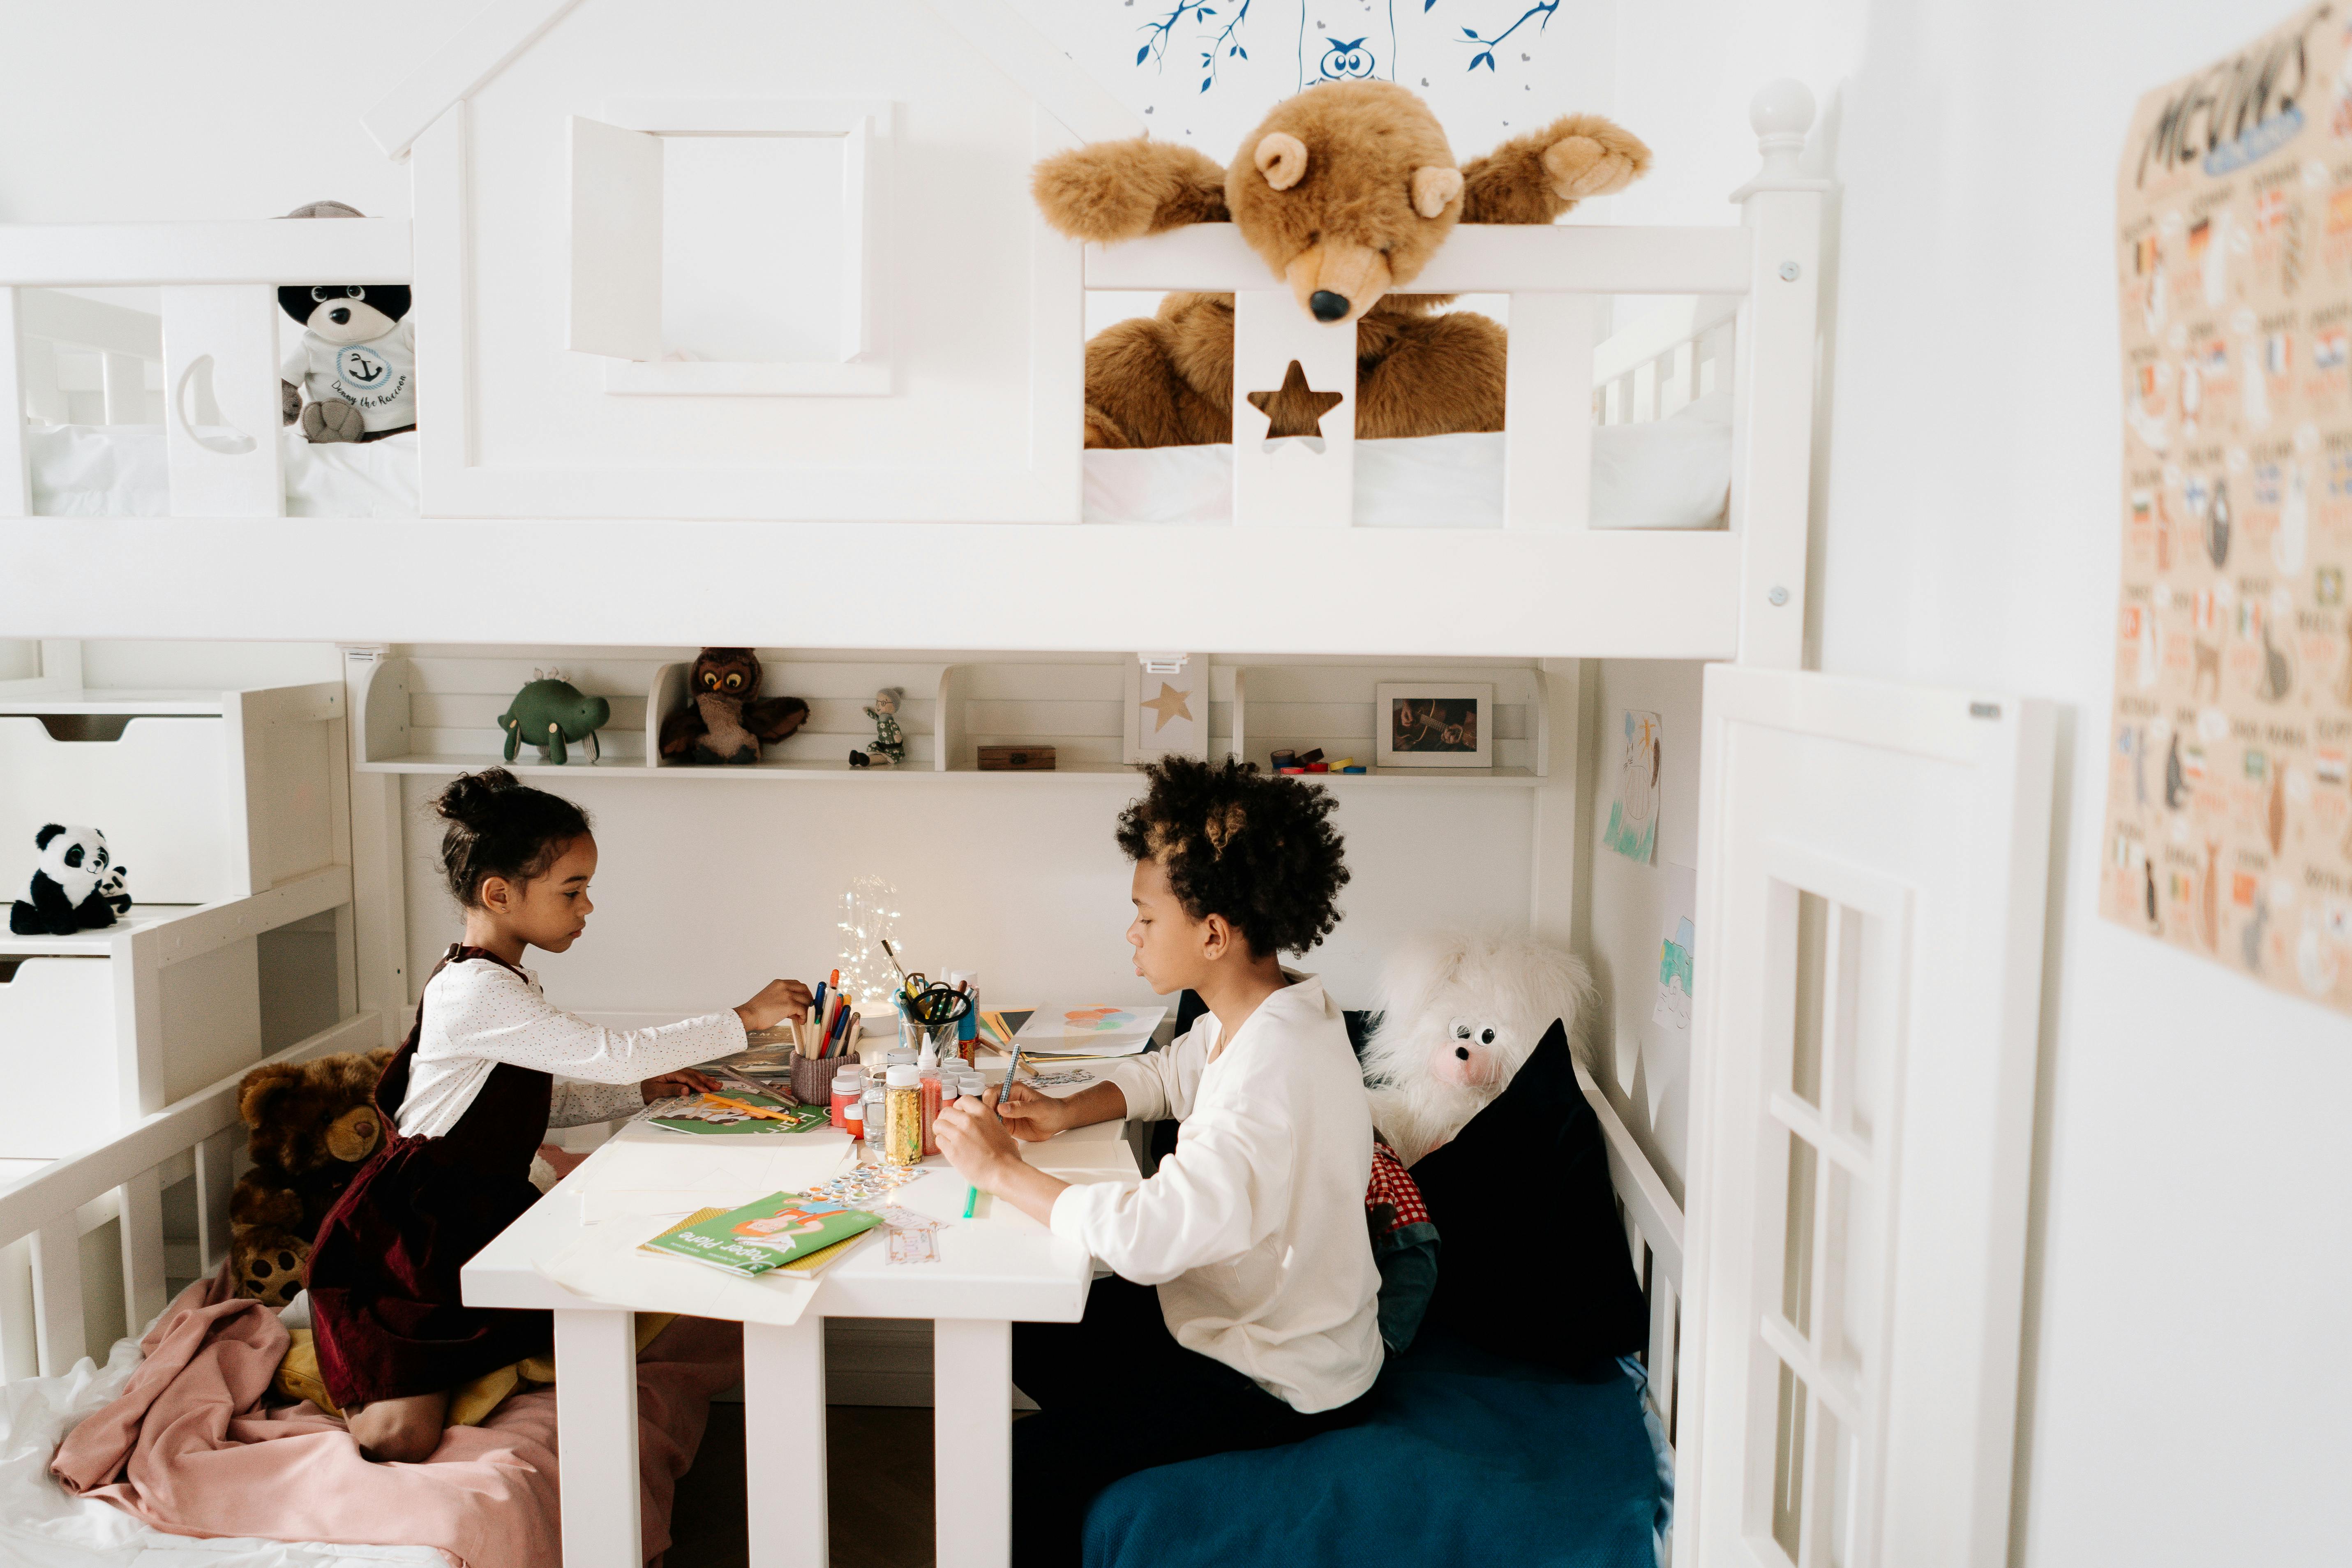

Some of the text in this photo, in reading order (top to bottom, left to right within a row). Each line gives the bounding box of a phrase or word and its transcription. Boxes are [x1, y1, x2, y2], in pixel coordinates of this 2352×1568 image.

[331, 374, 407, 409] Denny the Raccoon
[678, 1232, 724, 1249] Plane
[720, 1244, 772, 1261] Paper
